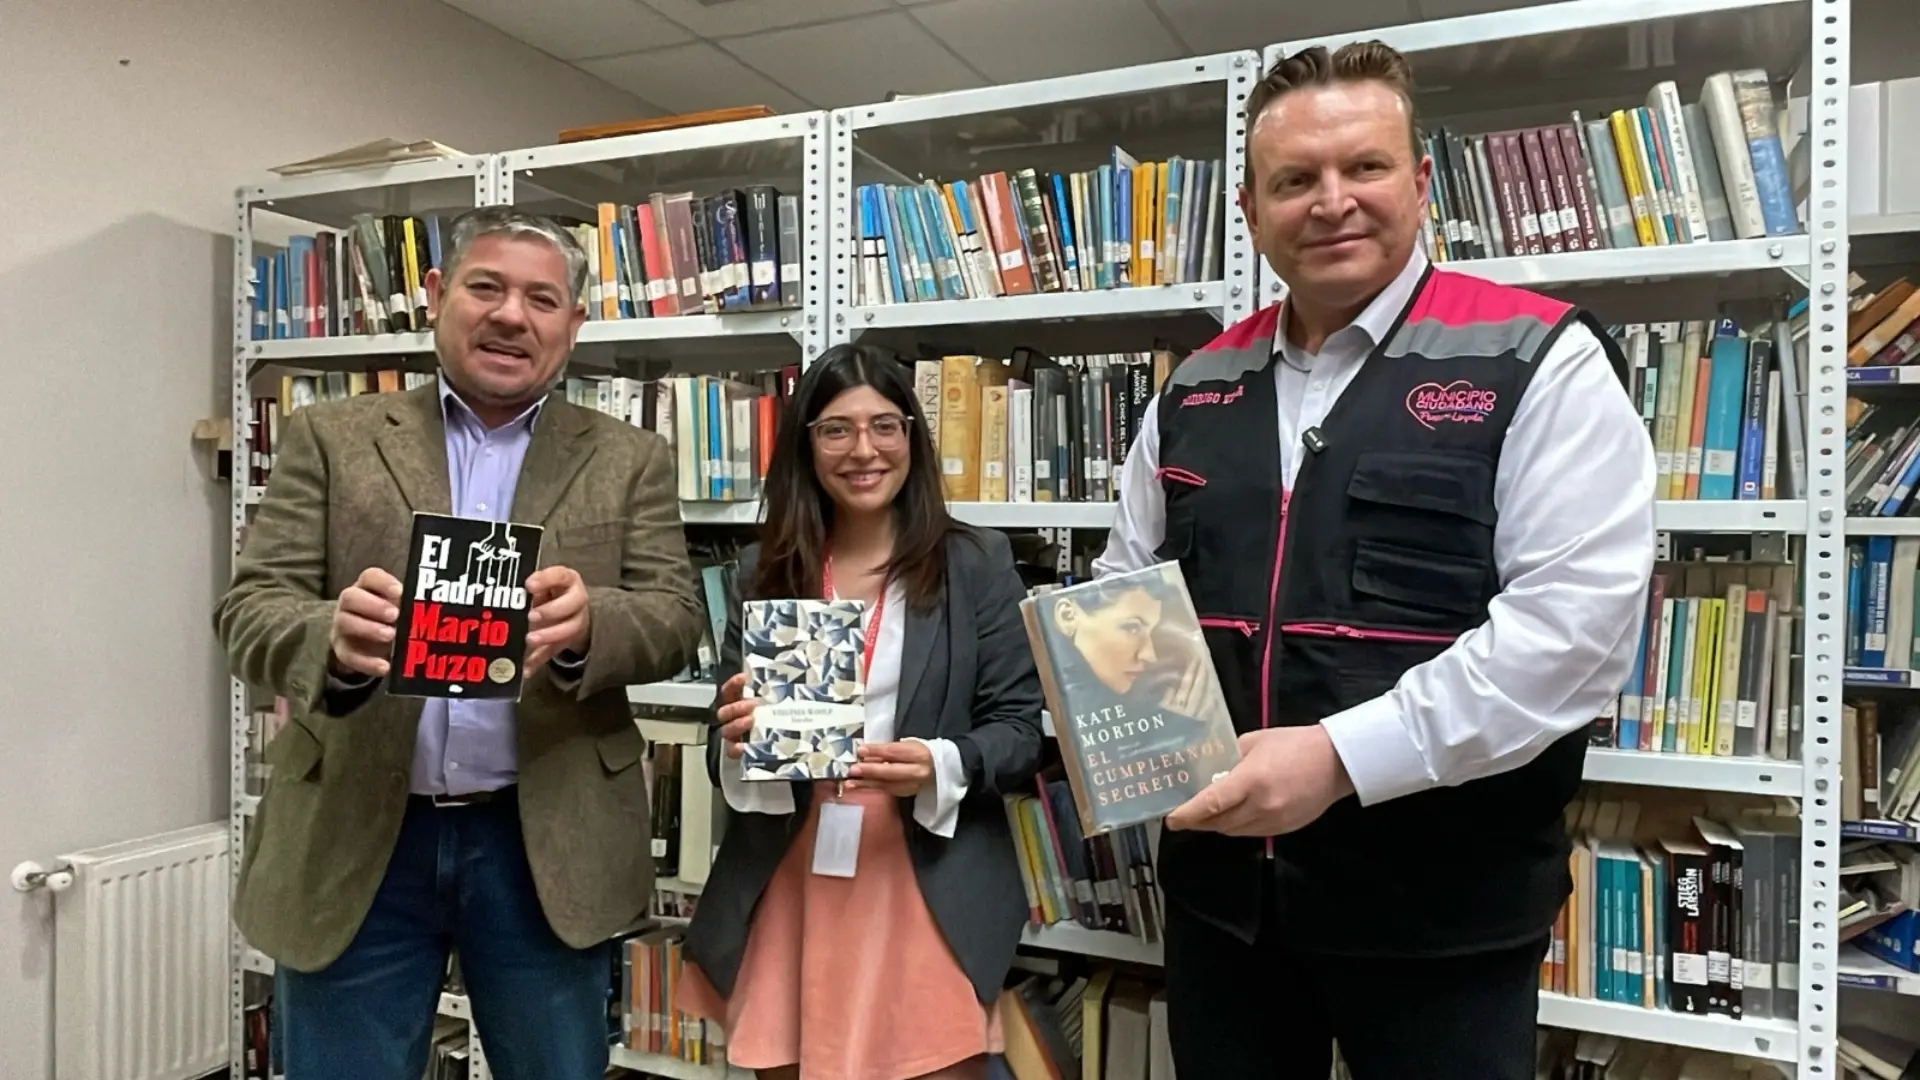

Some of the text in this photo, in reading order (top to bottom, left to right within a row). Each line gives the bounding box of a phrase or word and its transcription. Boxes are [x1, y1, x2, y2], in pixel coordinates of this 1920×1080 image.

[924, 373, 939, 406] KEN
[1119, 391, 1126, 402] LA
[1133, 369, 1142, 405] HAWKINS
[1140, 375, 1148, 399] PAULA
[1417, 390, 1497, 403] MUNICIPIO
[1119, 402, 1127, 426] CHICA
[1415, 400, 1495, 412] CIUDADANO
[419, 534, 451, 569] El
[414, 568, 526, 609] Padrino
[409, 602, 509, 646] Mario
[403, 640, 486, 682] Puzo
[1076, 704, 1127, 728] KATE
[1081, 713, 1165, 748] MORTON
[1087, 750, 1112, 769] EL
[1098, 769, 1190, 806] SECRETO
[1677, 877, 1690, 908] STIEG
[1685, 868, 1699, 917] LARSSON
